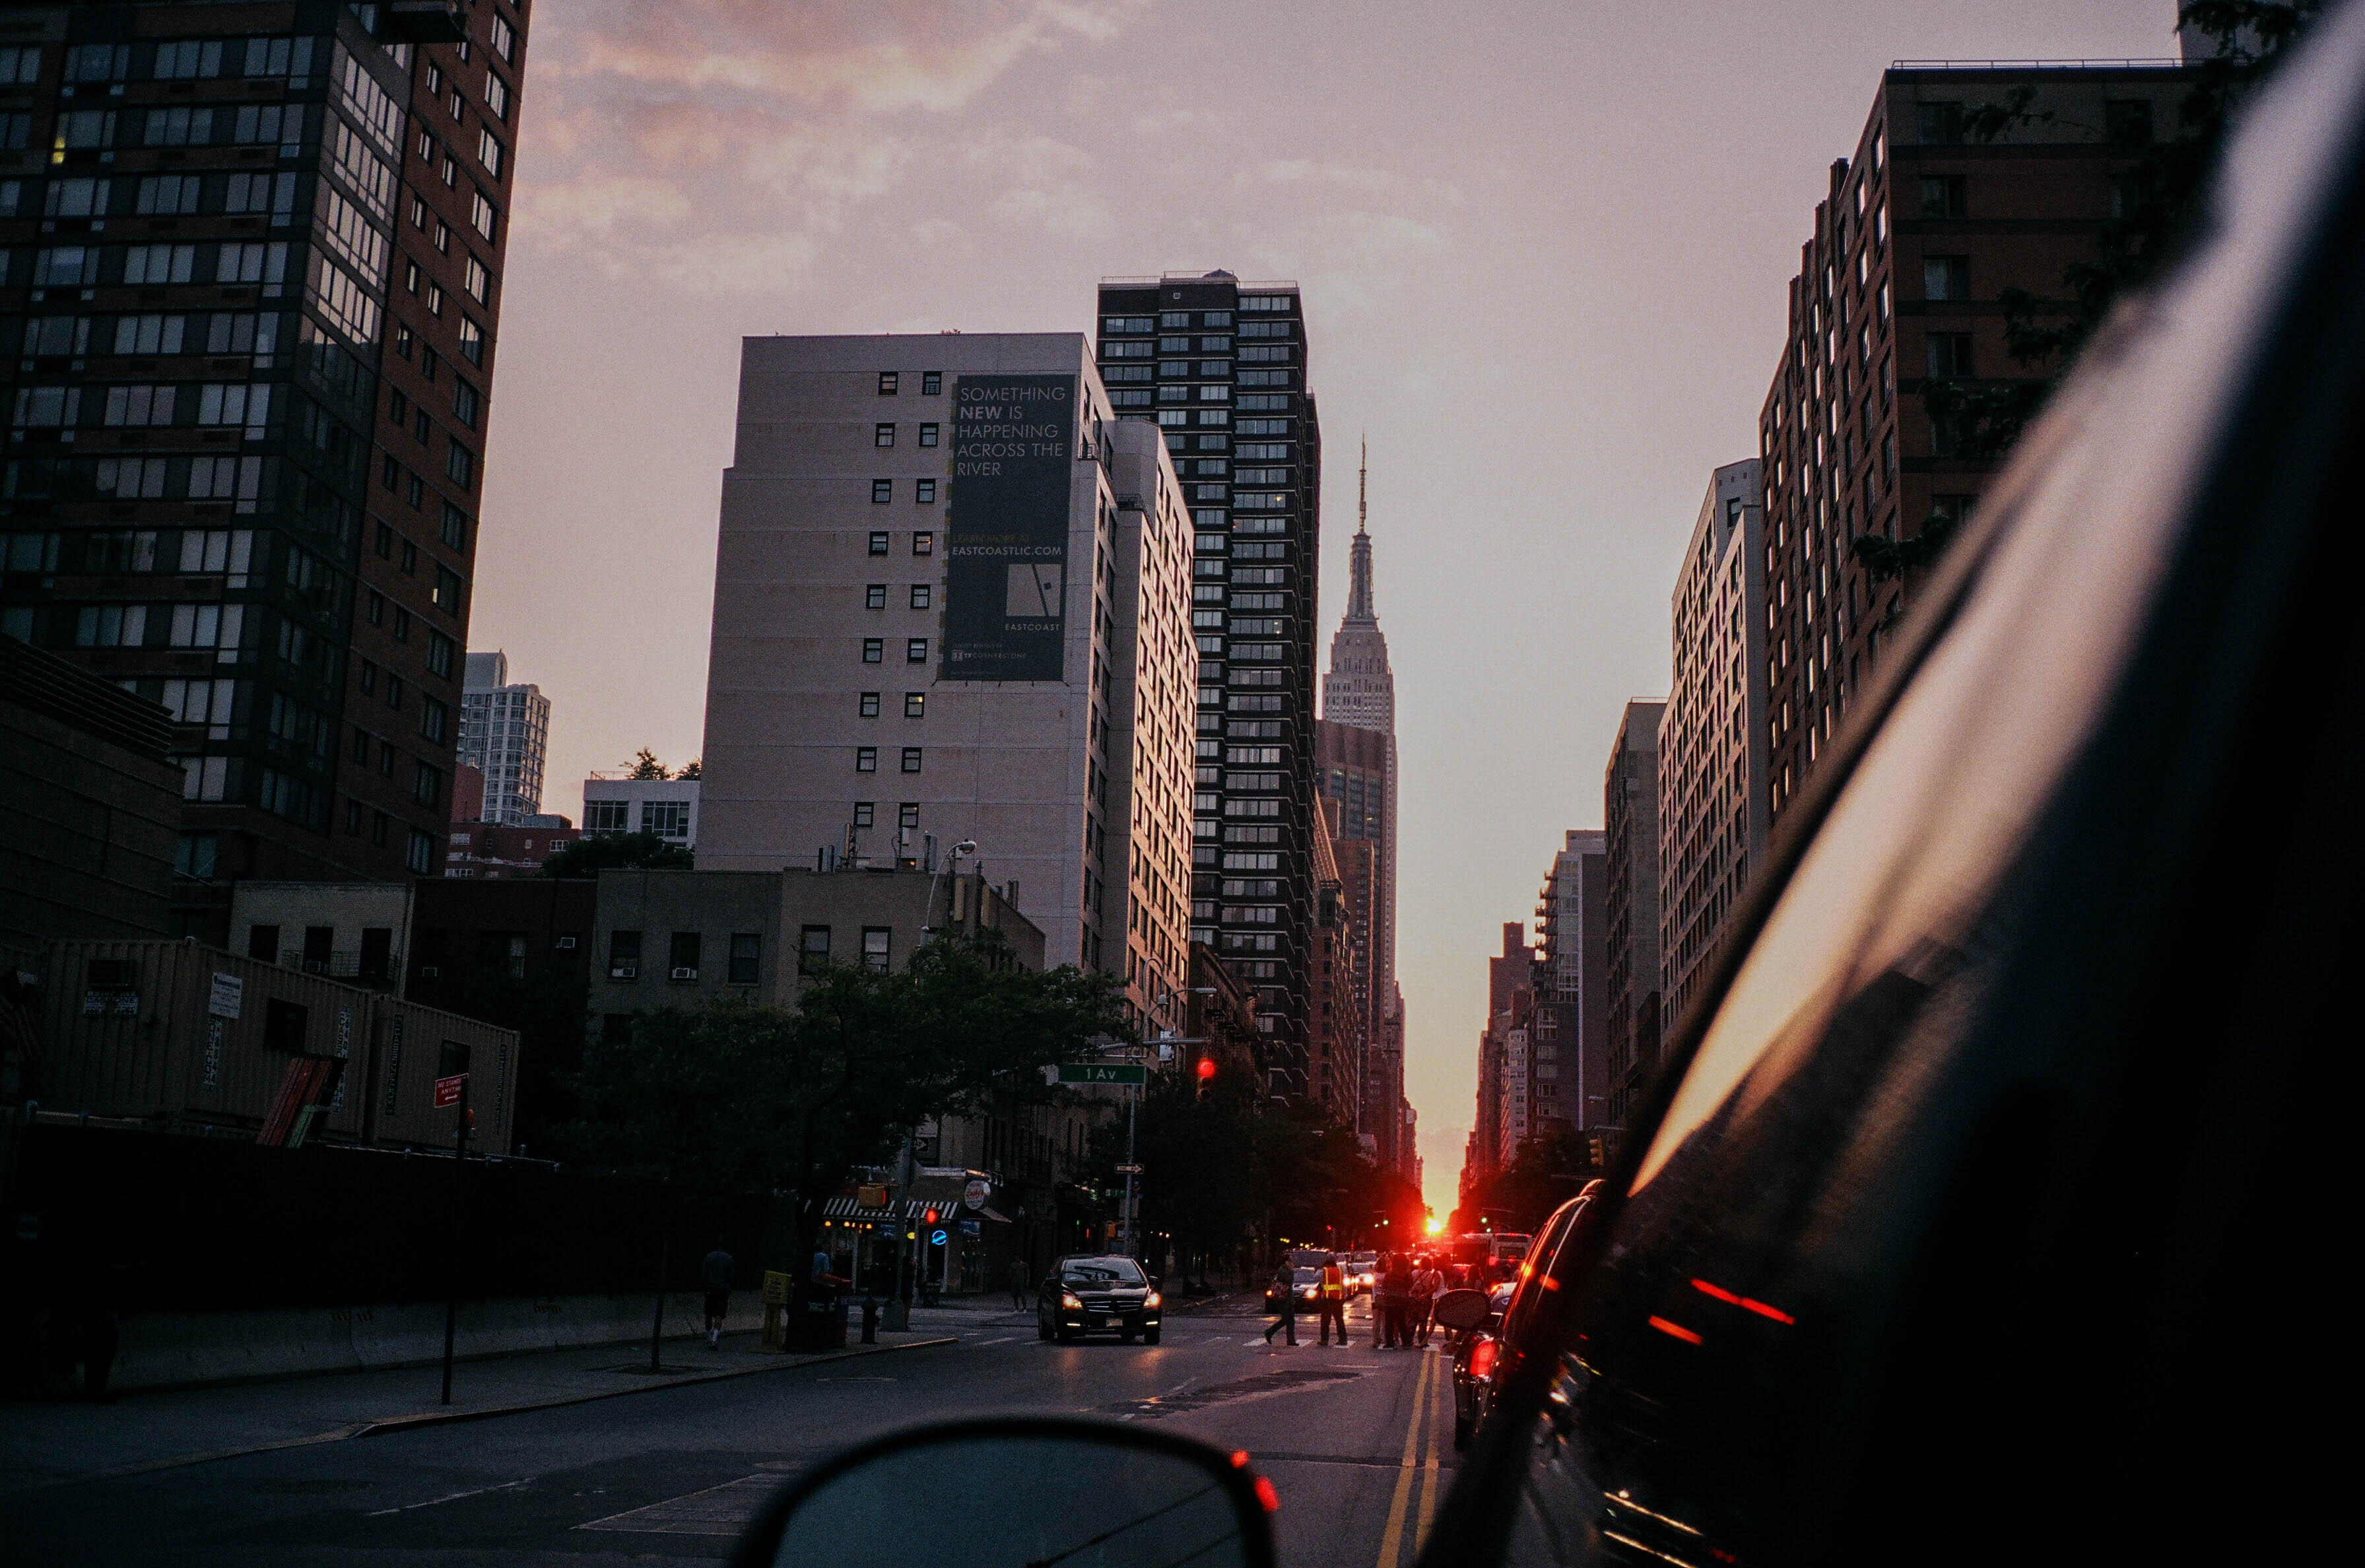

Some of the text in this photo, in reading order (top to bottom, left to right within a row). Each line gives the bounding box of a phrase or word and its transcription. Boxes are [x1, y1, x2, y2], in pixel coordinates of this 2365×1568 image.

[960, 387, 1065, 401] SOMETHING
[960, 406, 1023, 419] NEW IS
[959, 424, 1058, 438] HAPPENING
[957, 443, 1063, 457] ACROSS THE
[957, 463, 1001, 475] RIVER
[952, 546, 1061, 555] EASTCOASTLIC.COM
[1086, 1068, 1116, 1080] 1 Av
